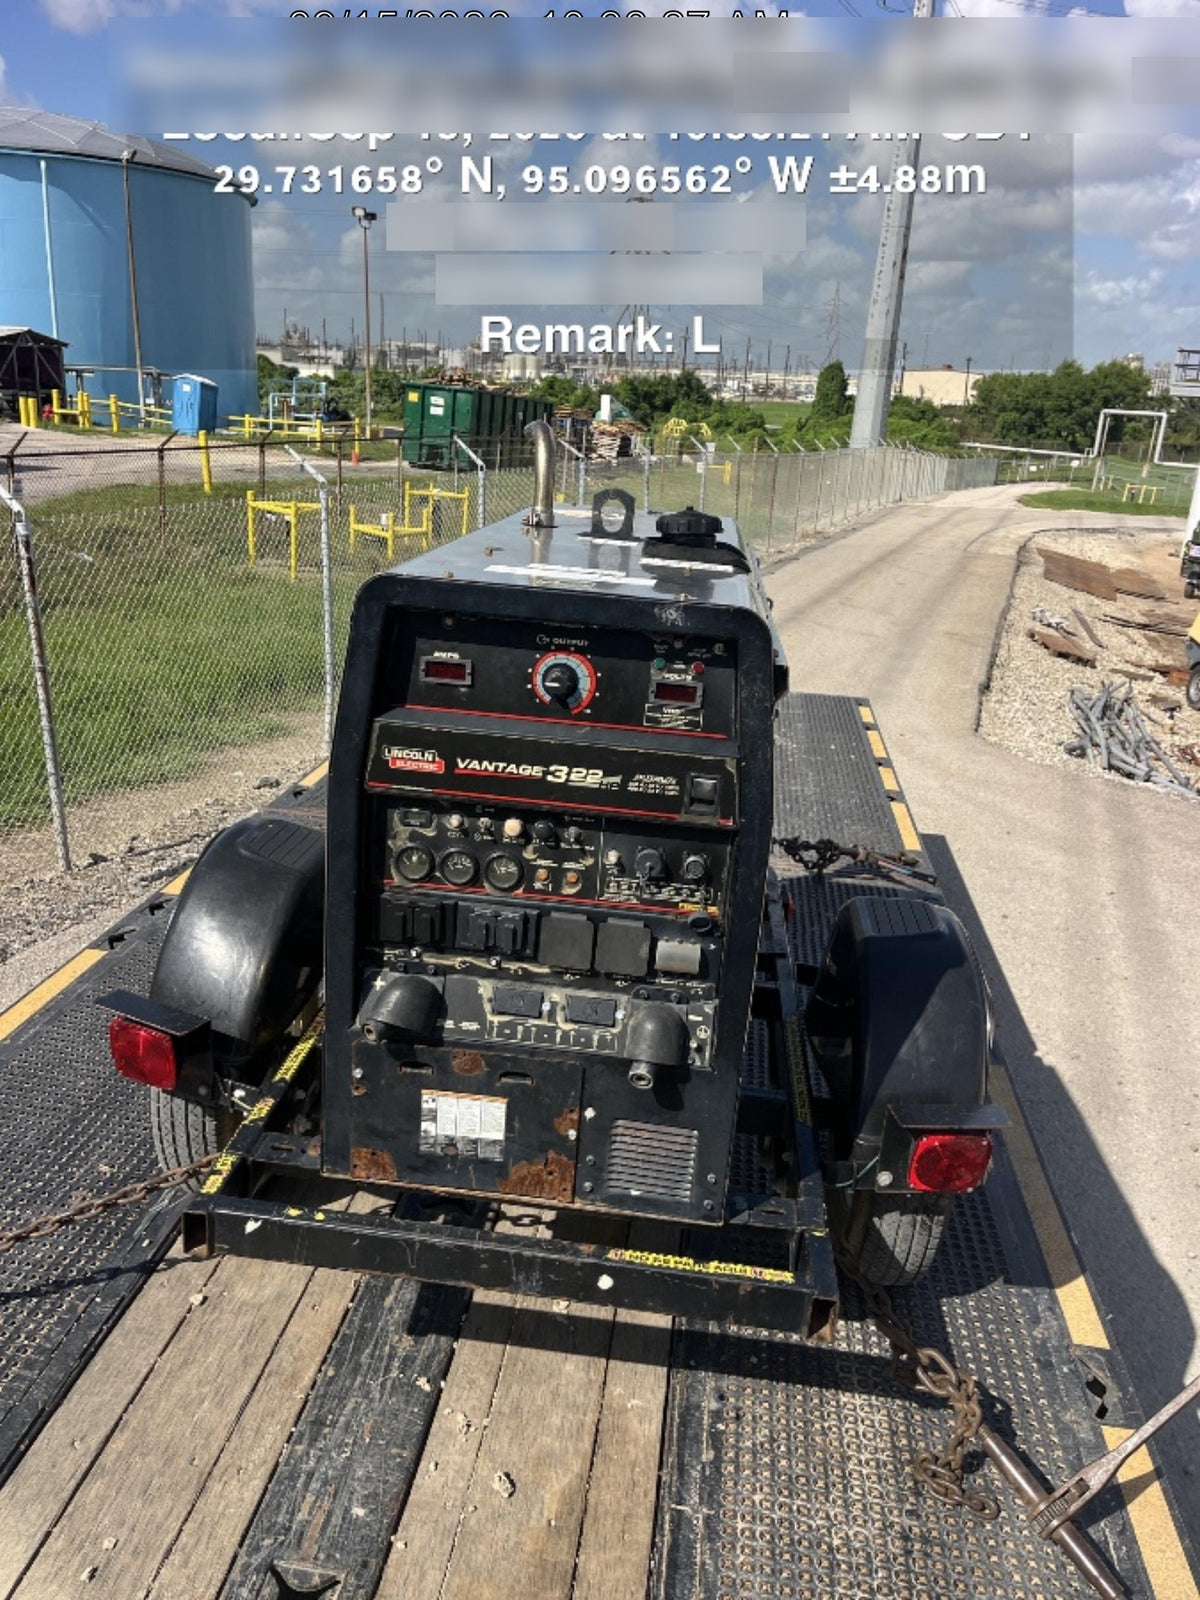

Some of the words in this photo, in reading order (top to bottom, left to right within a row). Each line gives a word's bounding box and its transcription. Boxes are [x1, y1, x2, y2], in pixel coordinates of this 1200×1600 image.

[384, 747, 434, 761] LINCOLN
[395, 759, 440, 771] ELECTRIC
[455, 757, 545, 777] VANTAGE
[546, 763, 604, 784] 322
